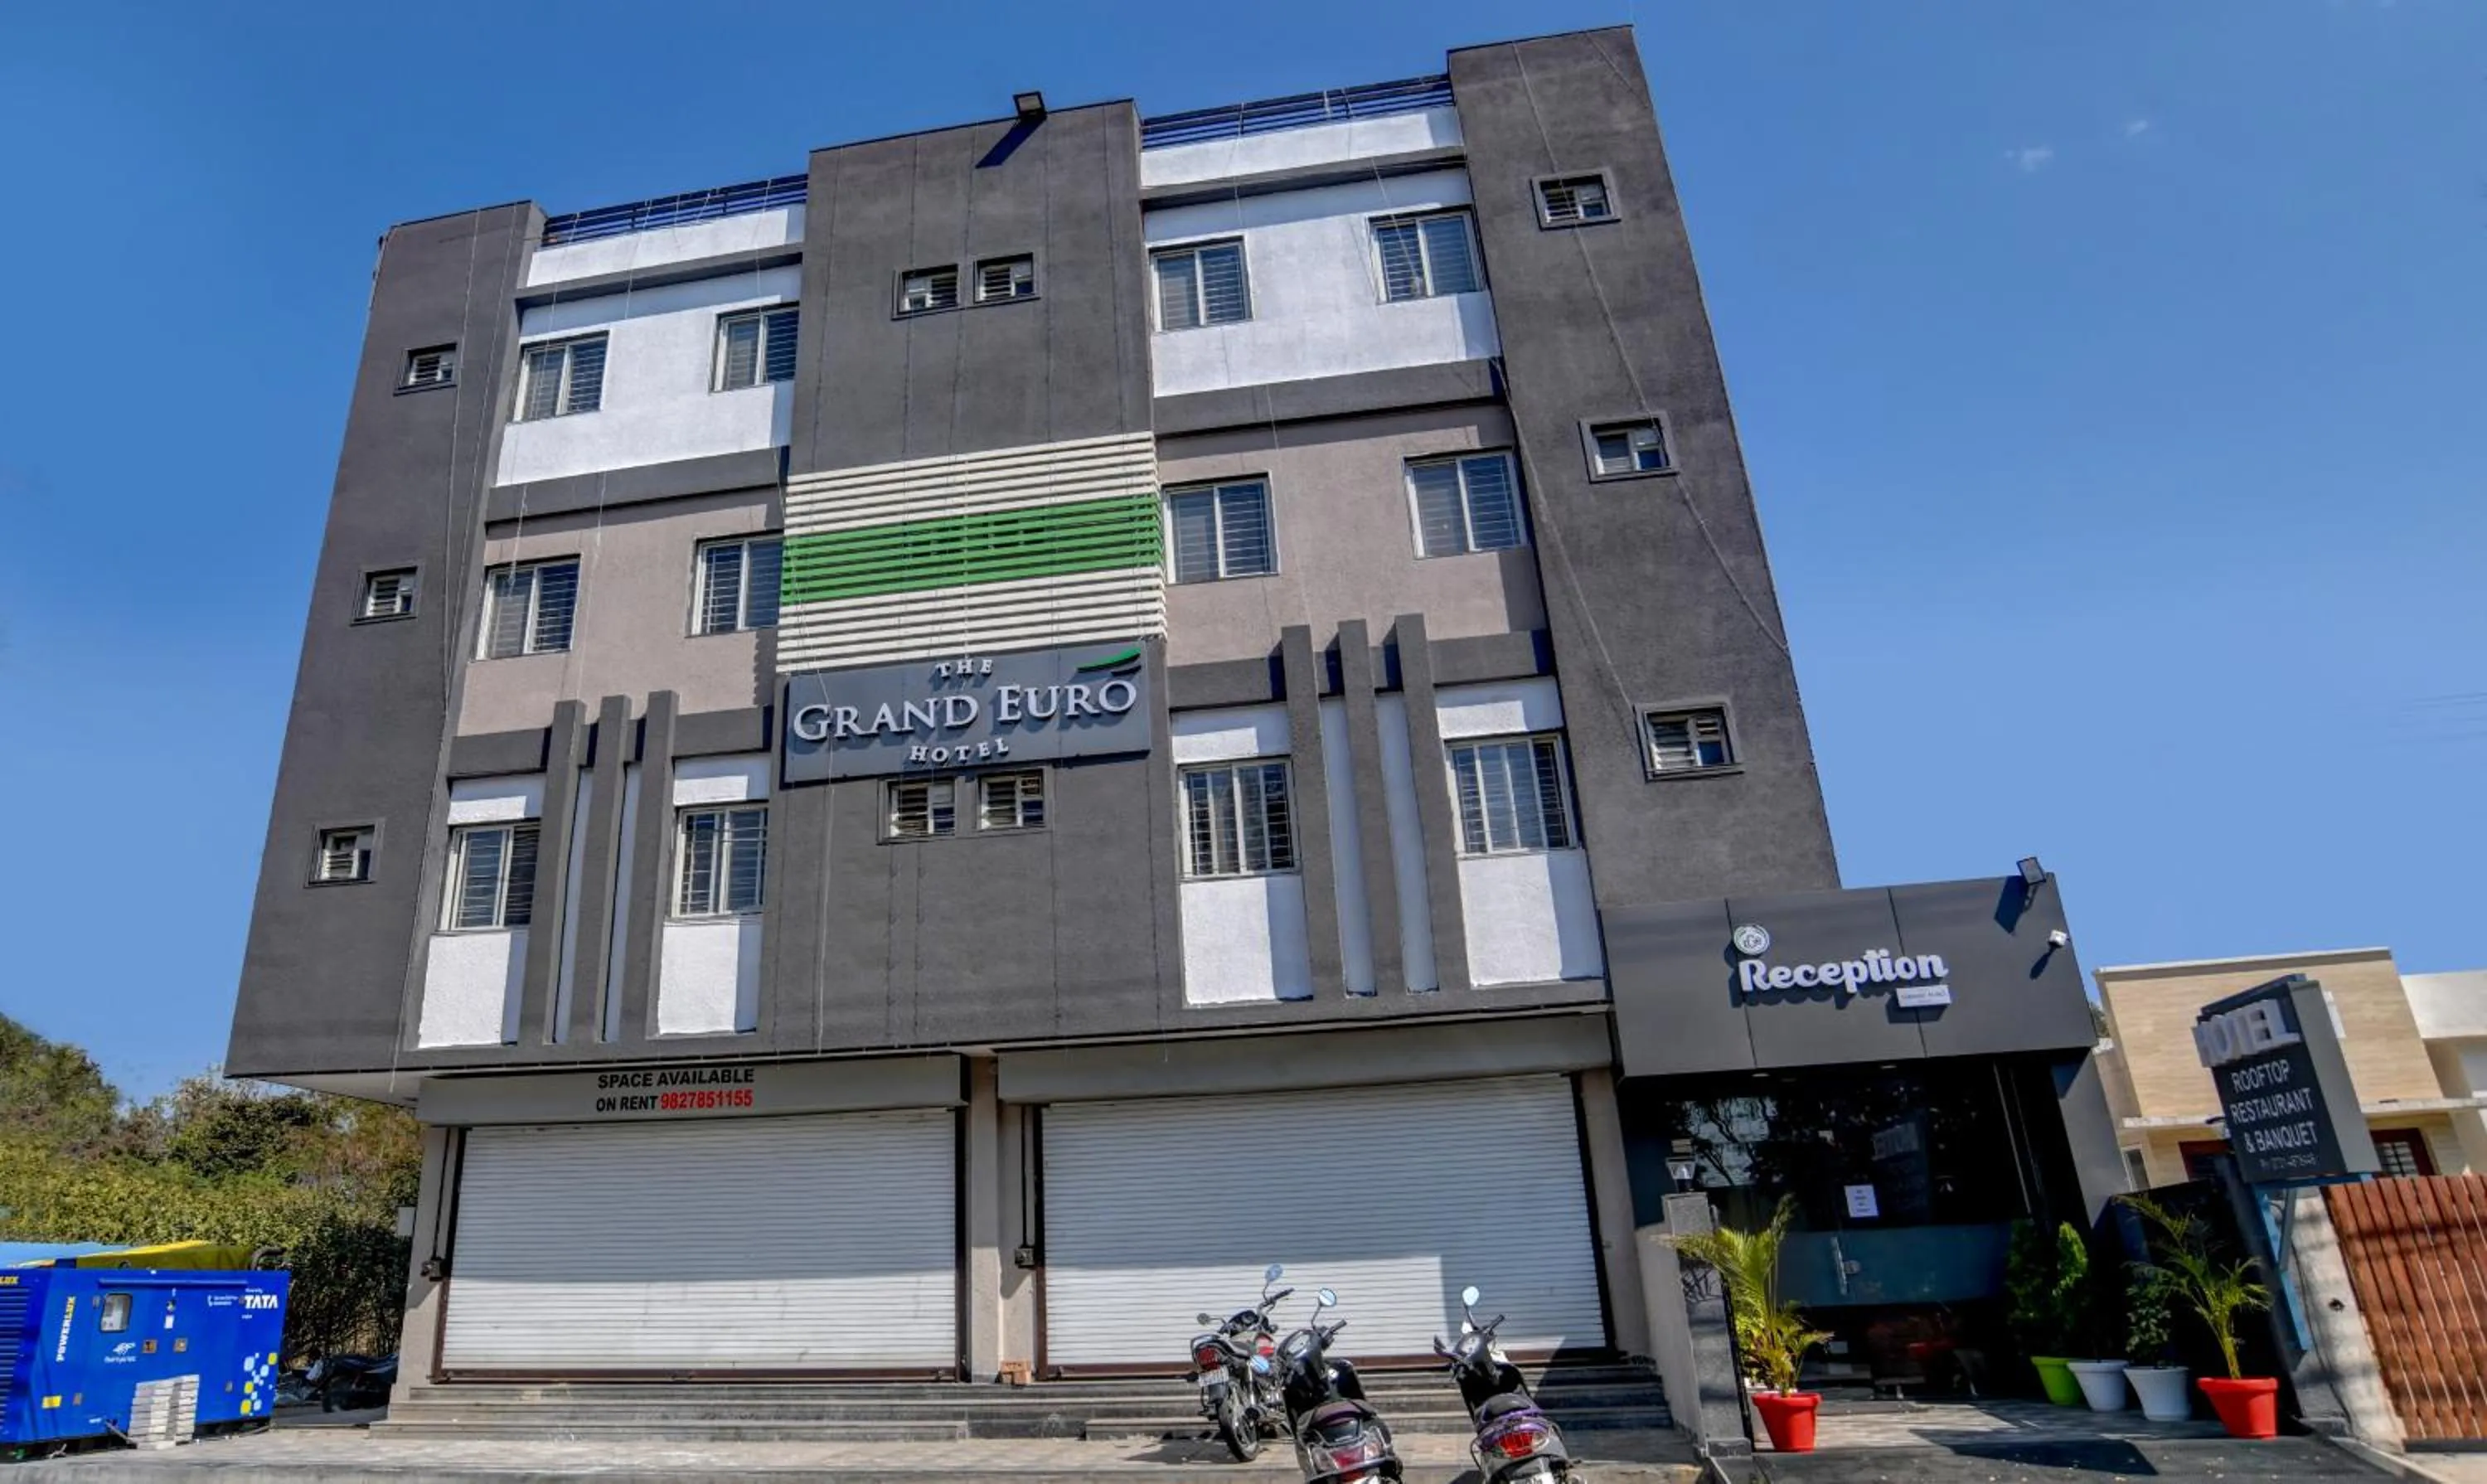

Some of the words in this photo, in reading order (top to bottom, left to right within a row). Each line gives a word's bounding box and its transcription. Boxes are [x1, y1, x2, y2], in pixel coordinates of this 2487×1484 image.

[937, 658, 993, 677] THE
[793, 695, 979, 741] GRAND
[997, 680, 1137, 722] EURO
[909, 737, 1009, 763] HOTEL
[1738, 948, 1949, 993] Reception
[597, 1072, 652, 1089] SPACE
[657, 1068, 755, 1086] AVAILABLE
[2231, 1059, 2291, 1094] ROOFTOP
[596, 1097, 616, 1113] ON
[620, 1094, 658, 1111] RENT
[660, 1088, 754, 1110] 9827851155
[2229, 1087, 2315, 1124] RESTAURANT
[2244, 1132, 2255, 1154] &
[2256, 1121, 2319, 1152] BANQUET
[245, 1293, 279, 1310] TATA
